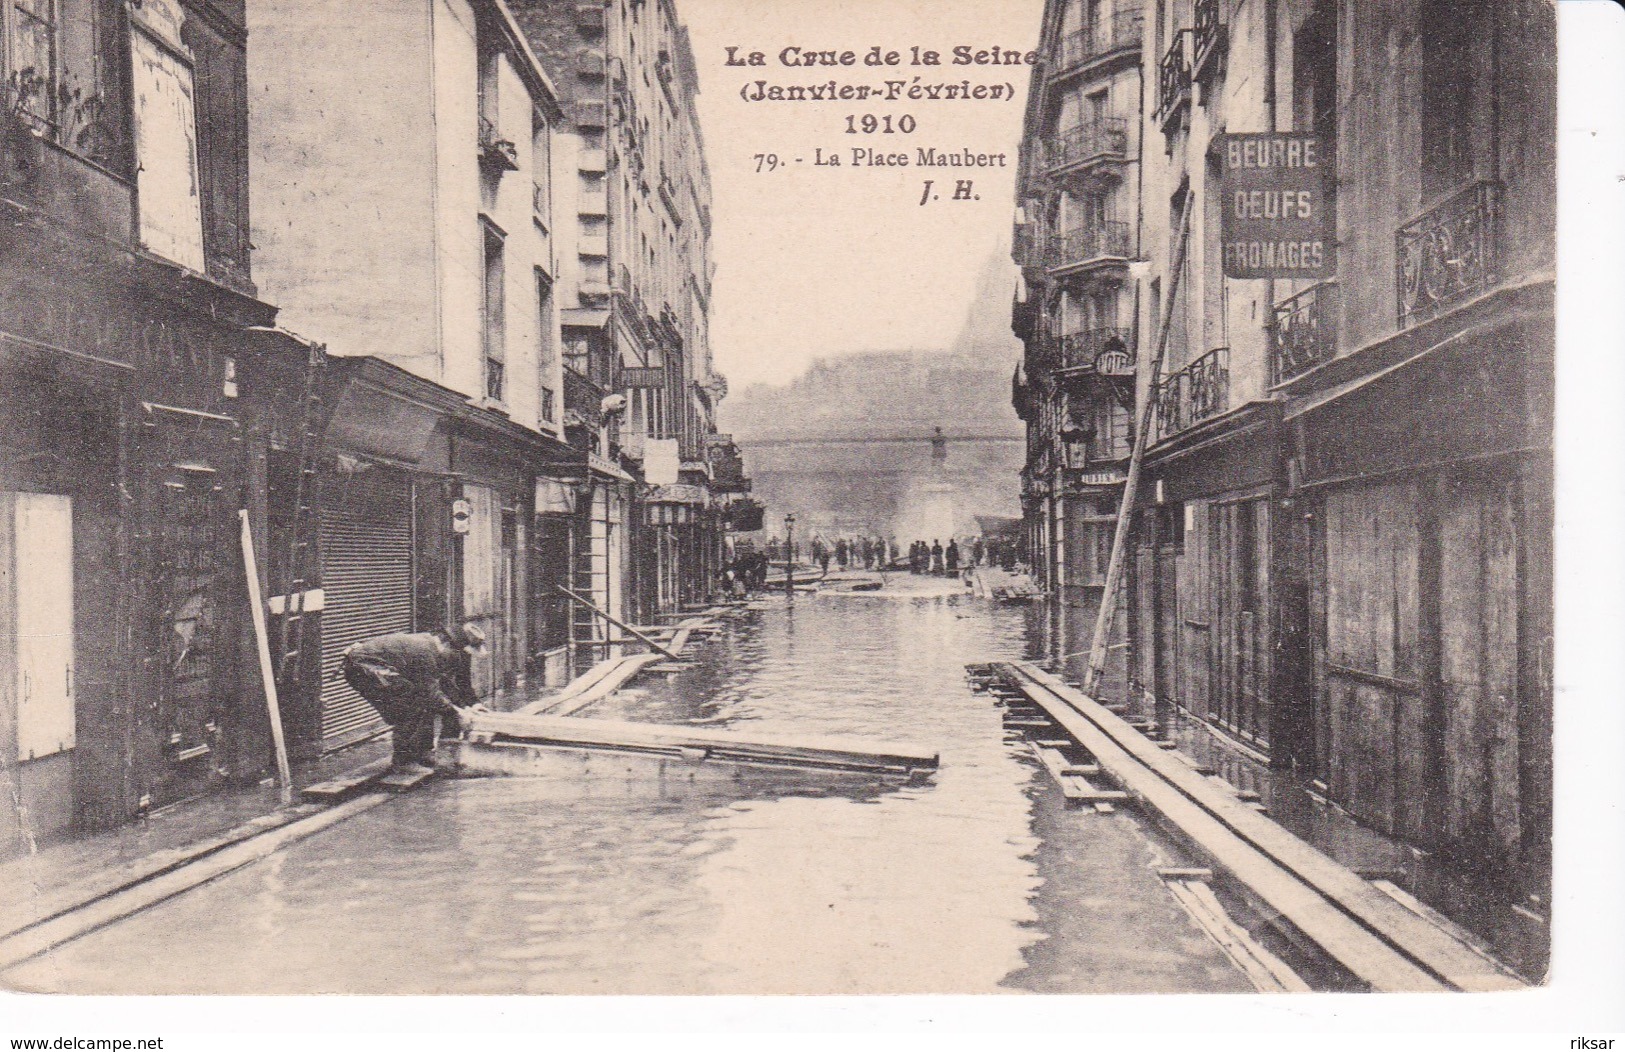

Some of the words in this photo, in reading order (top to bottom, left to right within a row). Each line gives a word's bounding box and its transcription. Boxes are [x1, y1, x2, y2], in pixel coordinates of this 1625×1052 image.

[1227, 140, 1317, 168] BEURRE
[1234, 190, 1312, 219] OEUFS
[1225, 240, 1324, 269] FROMAGES
